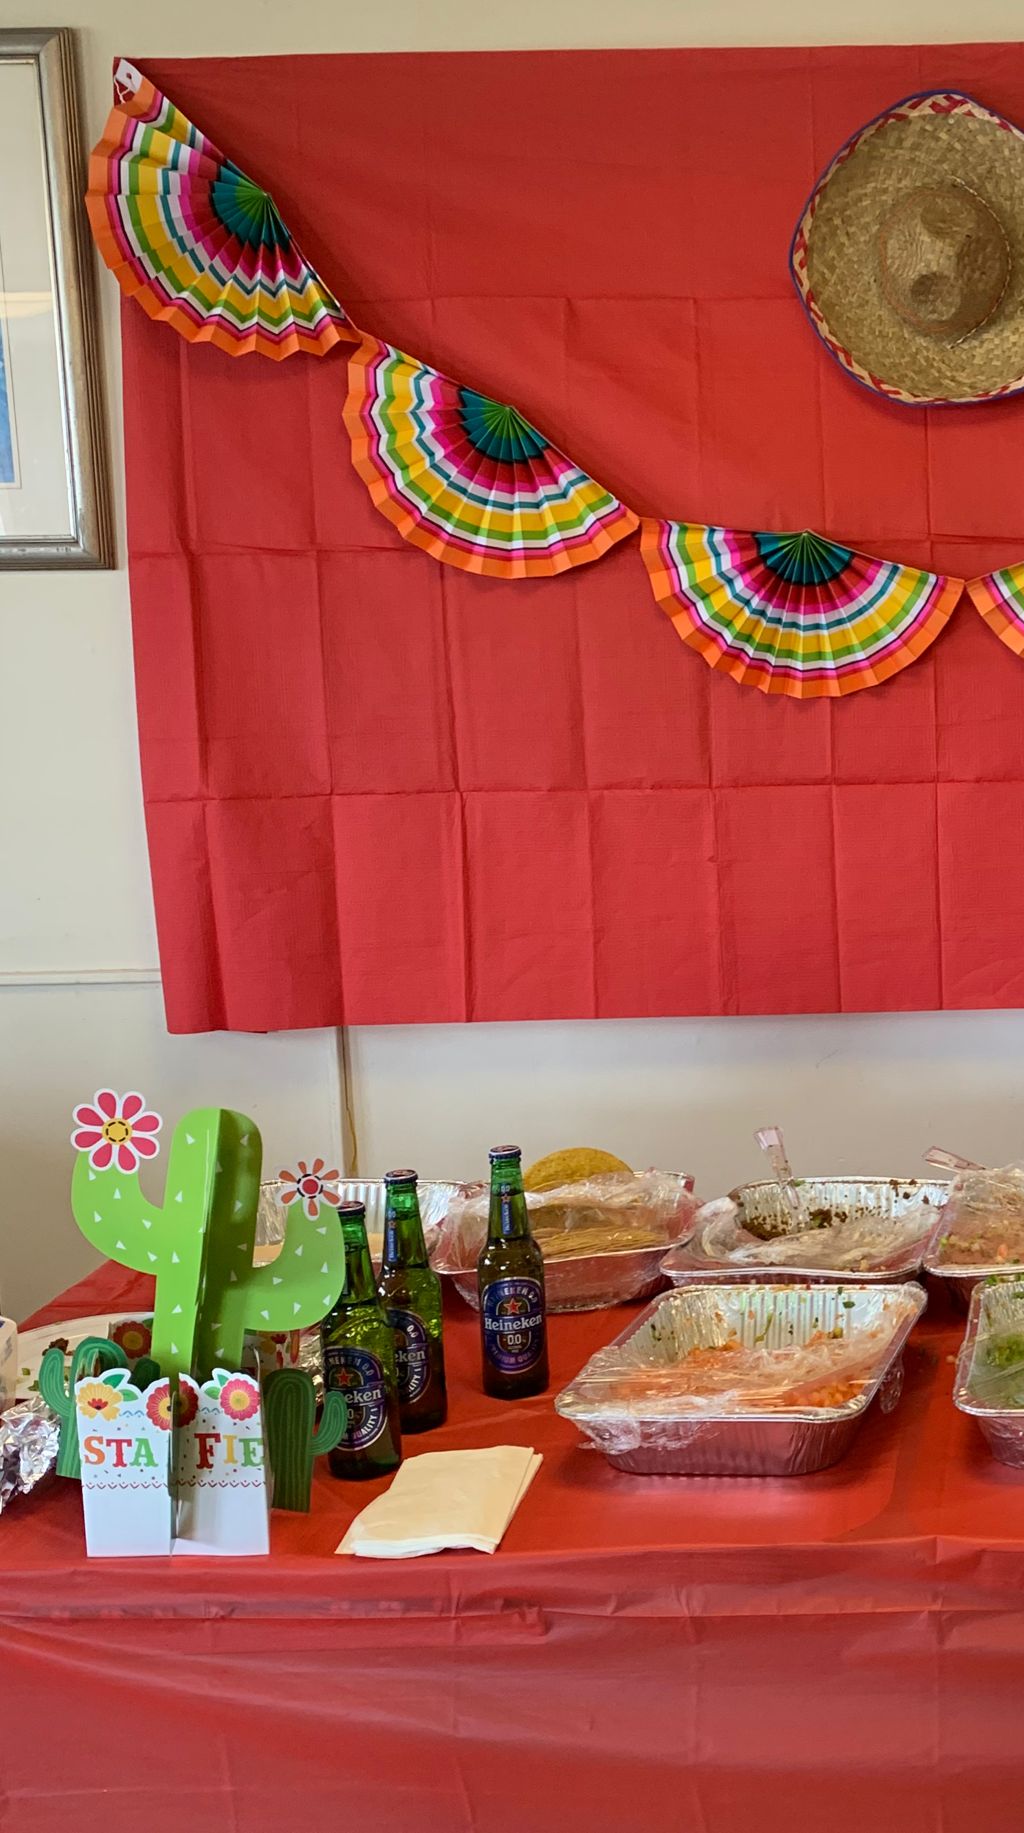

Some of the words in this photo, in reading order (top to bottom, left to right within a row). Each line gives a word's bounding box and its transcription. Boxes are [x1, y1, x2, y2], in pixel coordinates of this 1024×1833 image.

[484, 1314, 543, 1331] Heineken
[83, 1435, 160, 1468] STA
[193, 1431, 264, 1470] FIE
